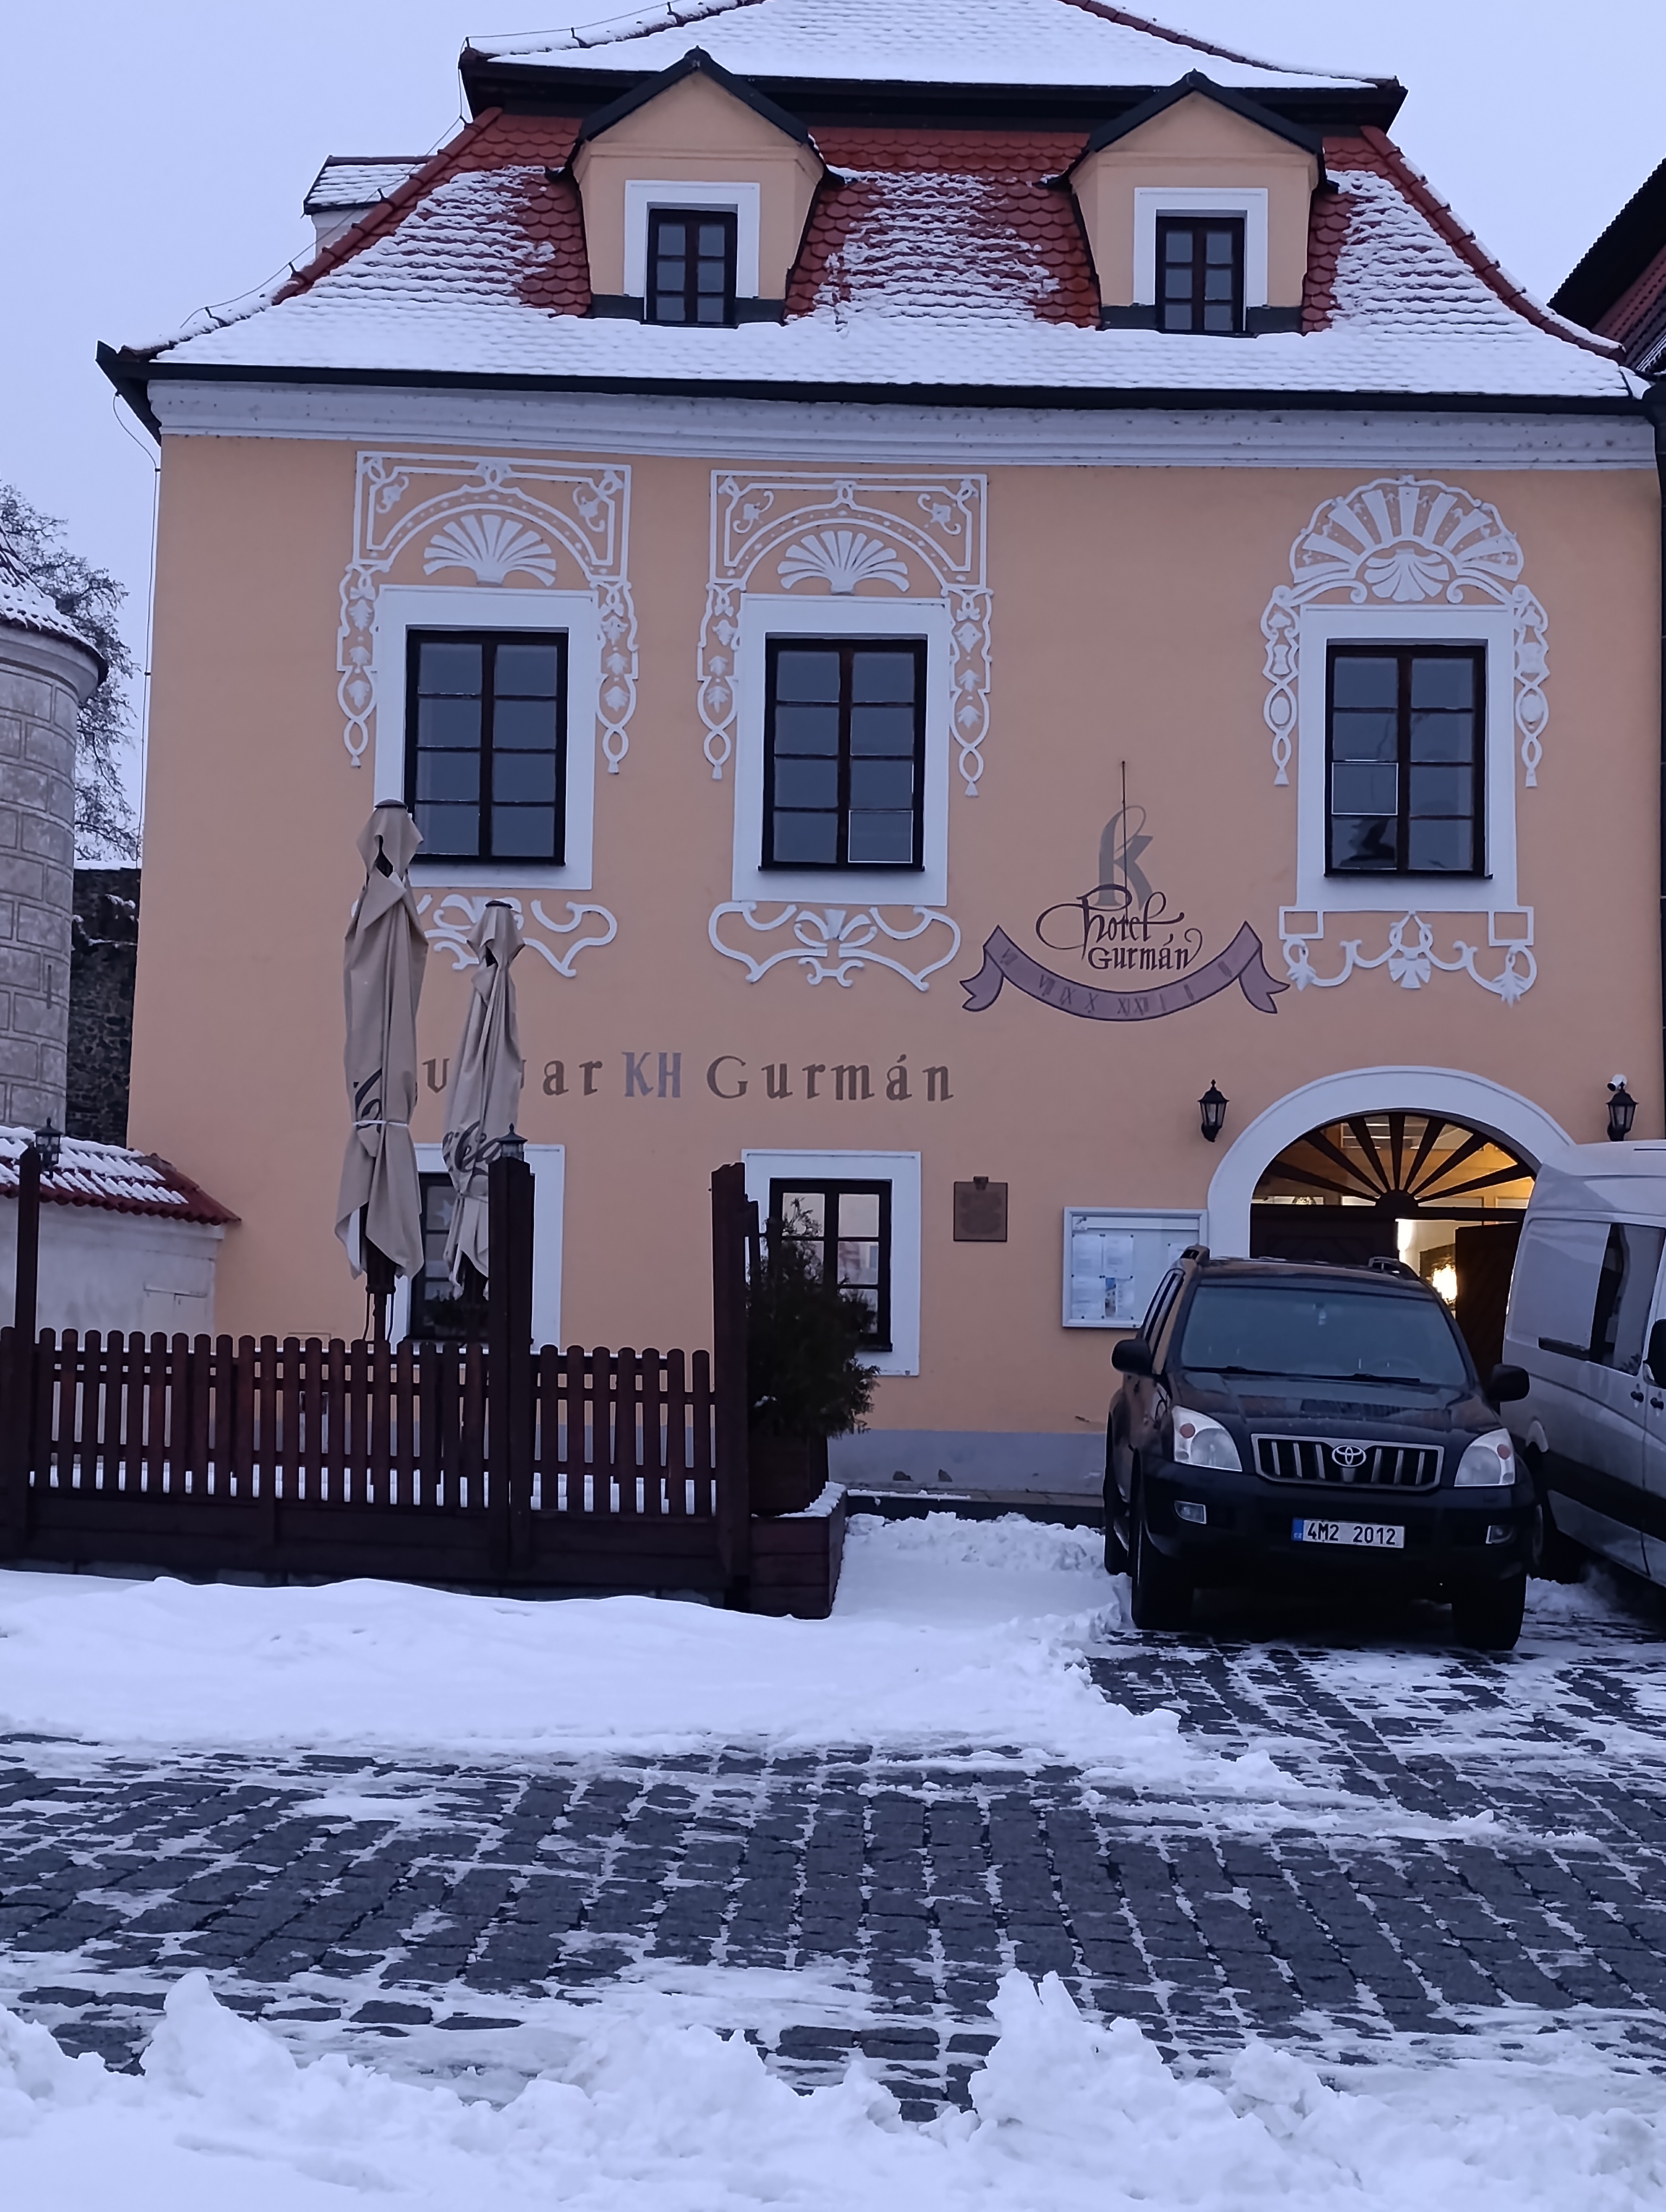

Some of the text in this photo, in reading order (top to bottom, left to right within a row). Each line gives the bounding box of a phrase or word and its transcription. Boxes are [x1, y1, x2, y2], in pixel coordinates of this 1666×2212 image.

[1088, 928, 1202, 971] Gurmán
[621, 1052, 682, 1098] KH
[707, 1054, 953, 1102] Gurmán
[1307, 1522, 1396, 1545] 4M2 2012
